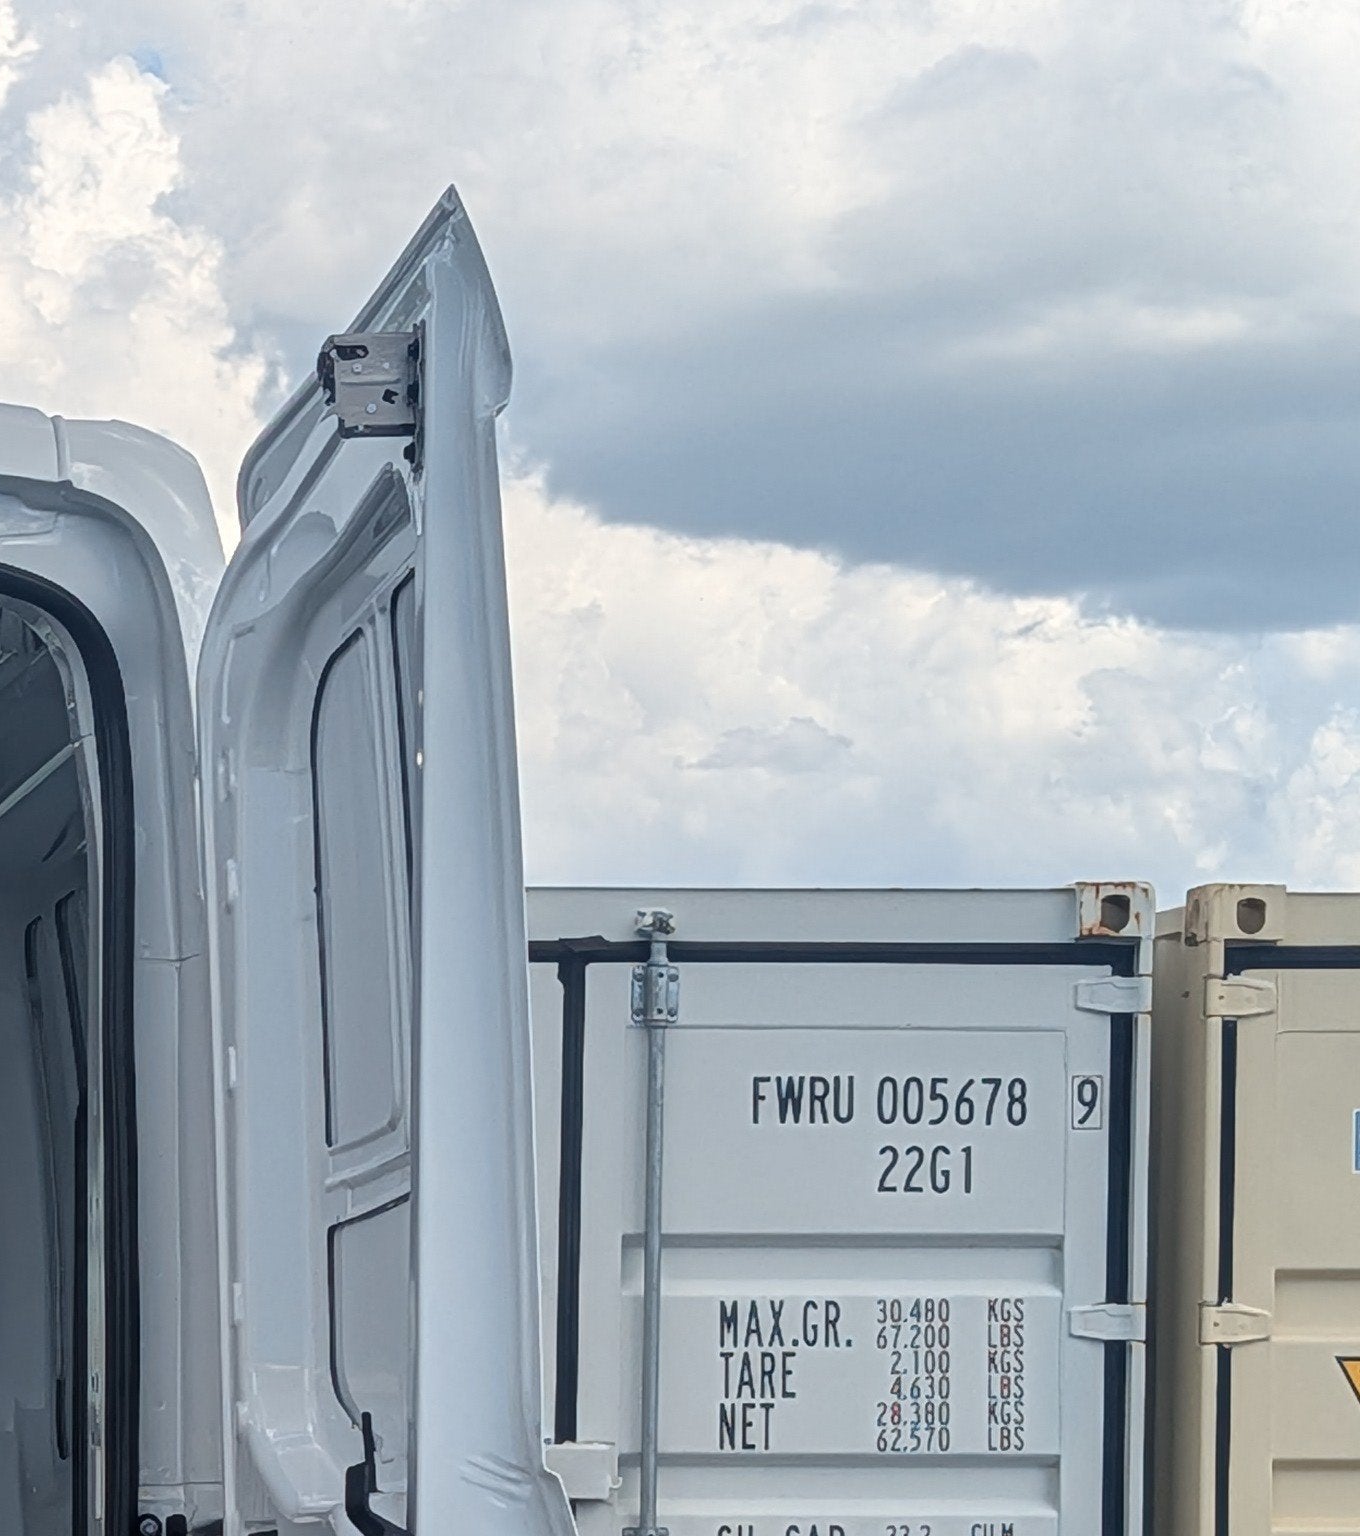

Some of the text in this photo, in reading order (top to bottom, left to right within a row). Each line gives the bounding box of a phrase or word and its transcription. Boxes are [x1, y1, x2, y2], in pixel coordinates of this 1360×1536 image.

[751, 1075, 1098, 1127] FWRU 005678 9
[877, 1145, 973, 1195] 22G1
[876, 1298, 1025, 1323] 30.480 KGS
[719, 1299, 853, 1349] MAX.GR.
[876, 1324, 1025, 1349] 67.200 LBS
[719, 1350, 797, 1399] TARE
[890, 1350, 1025, 1375] 2.100 KGS
[987, 1375, 1025, 1400] LBS
[987, 1401, 1025, 1426] KGS
[718, 1402, 775, 1451] NET
[987, 1426, 1025, 1451] LBS
